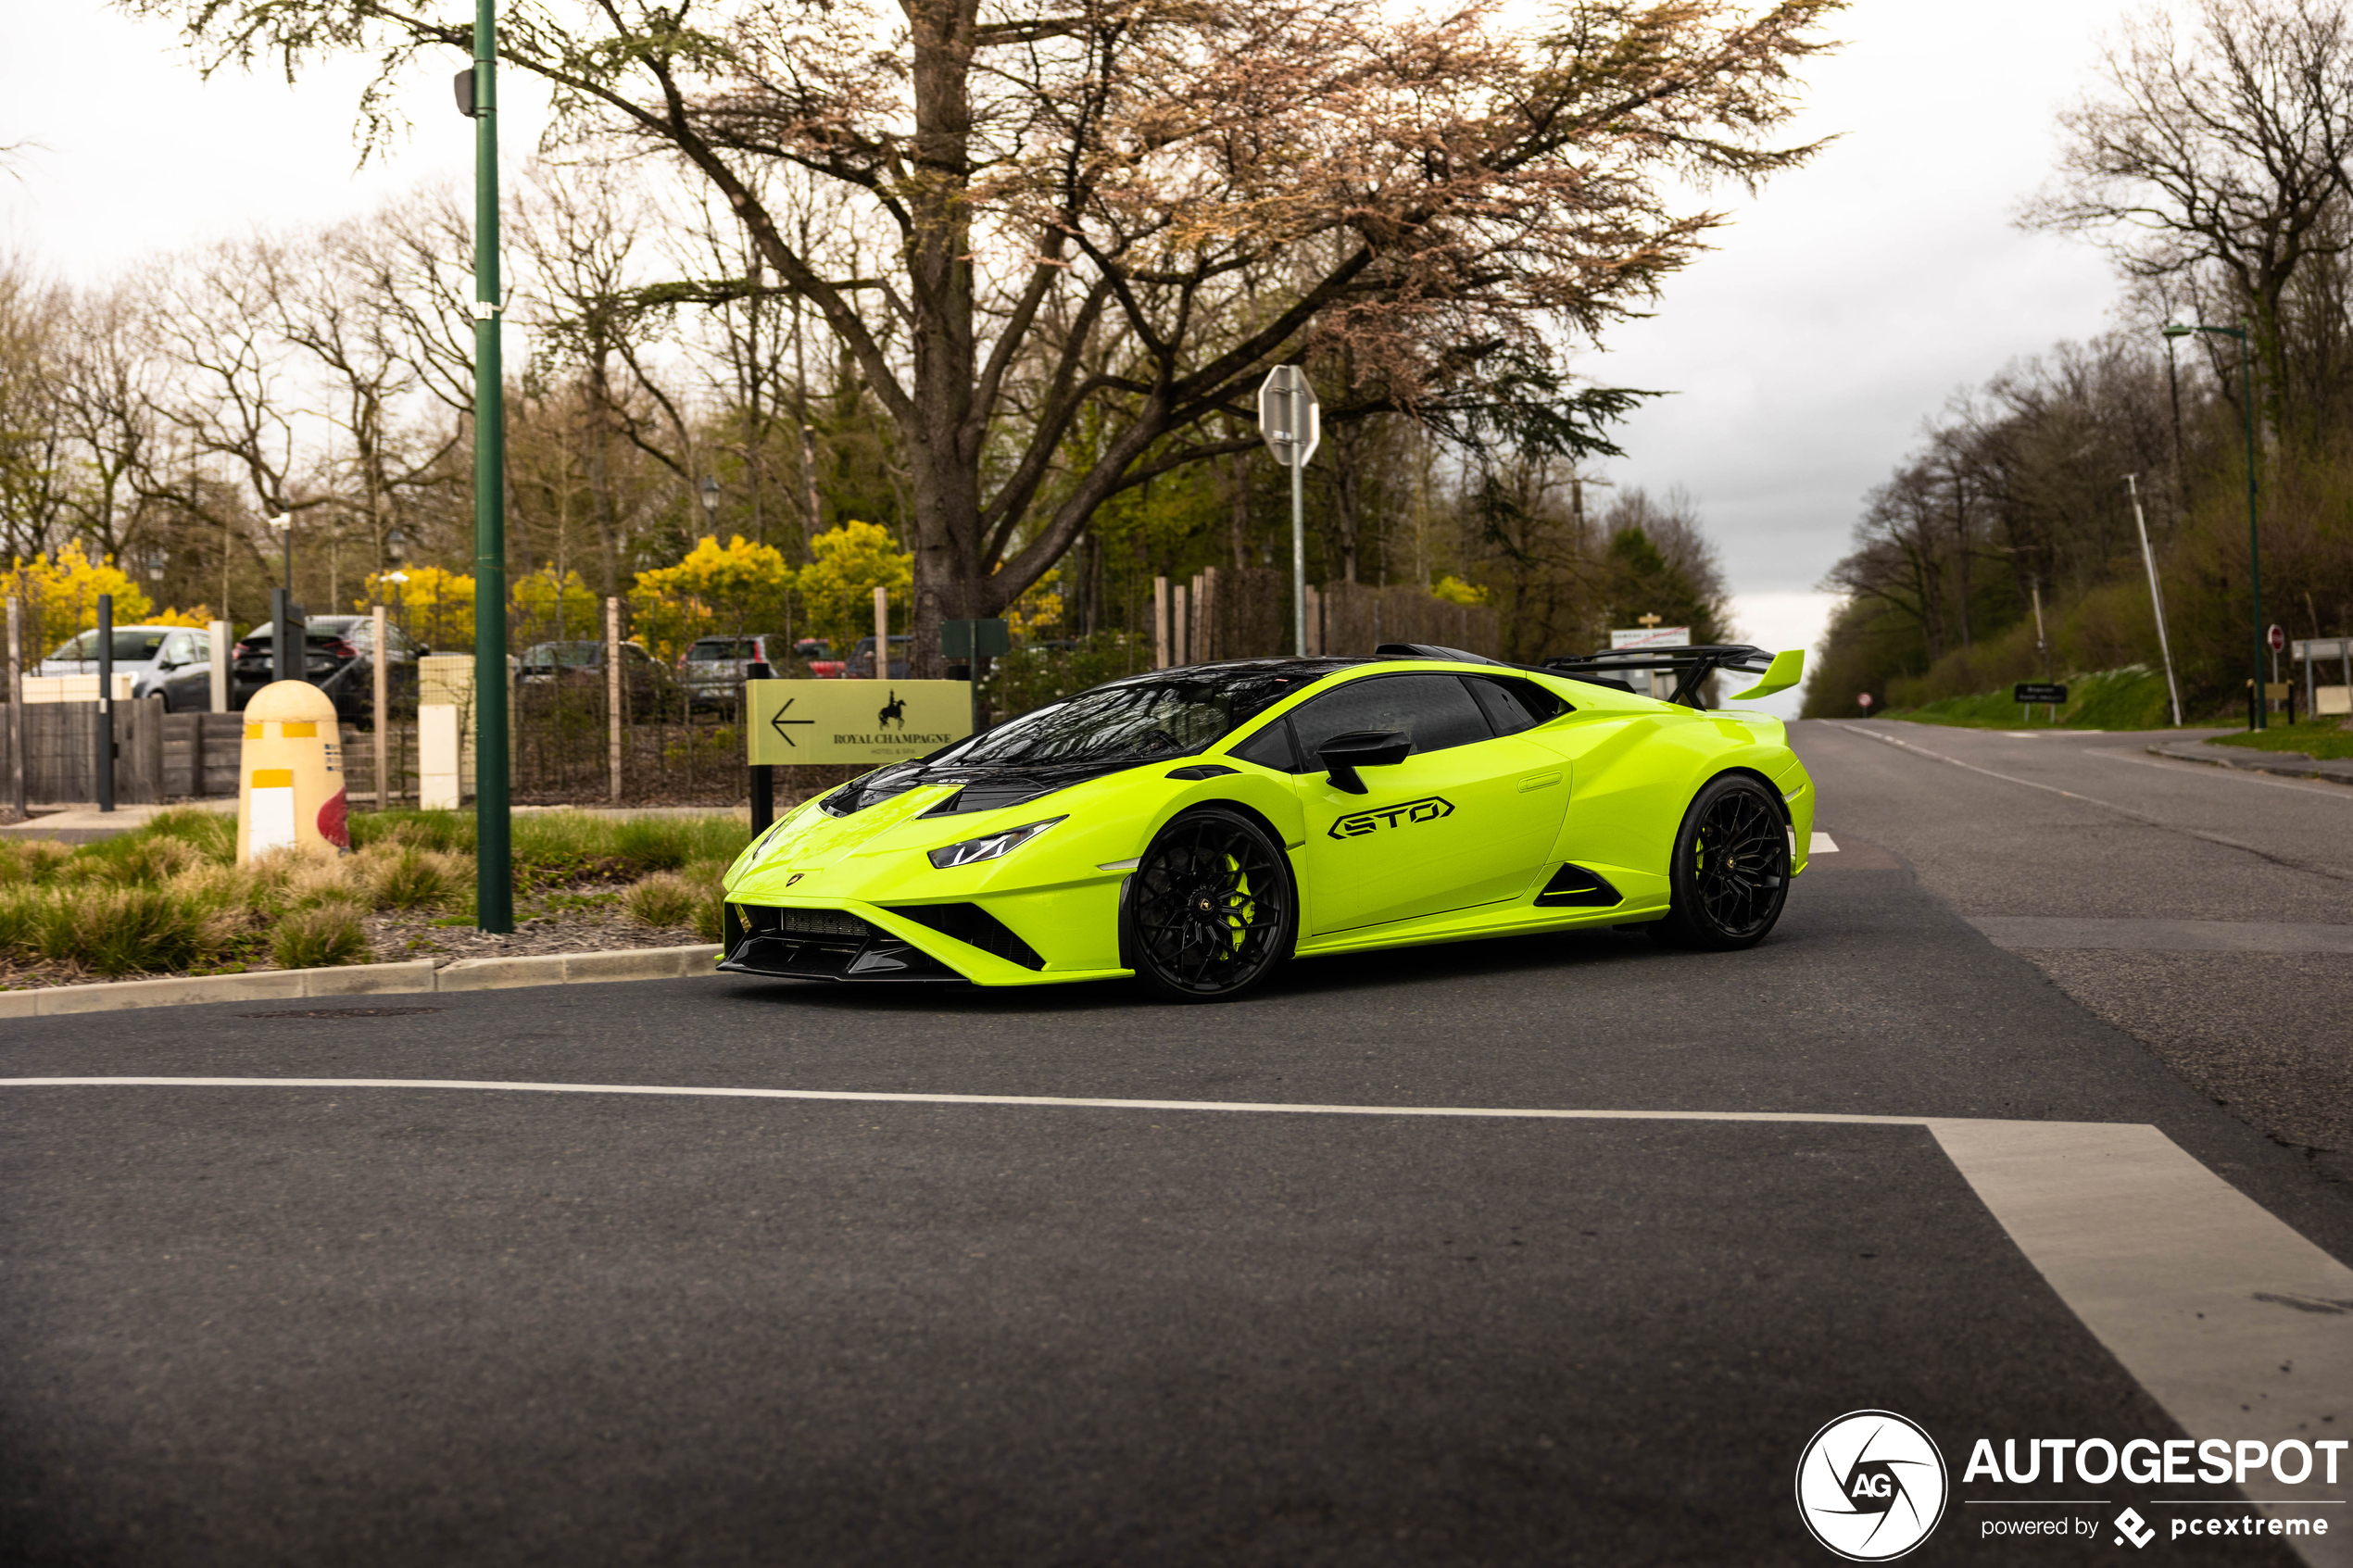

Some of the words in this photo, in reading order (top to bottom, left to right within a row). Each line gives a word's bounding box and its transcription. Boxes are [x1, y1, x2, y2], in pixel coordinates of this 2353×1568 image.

[834, 734, 872, 744] ROYAL
[875, 734, 951, 744] CHAMPAGNE
[1343, 802, 1440, 837] STO
